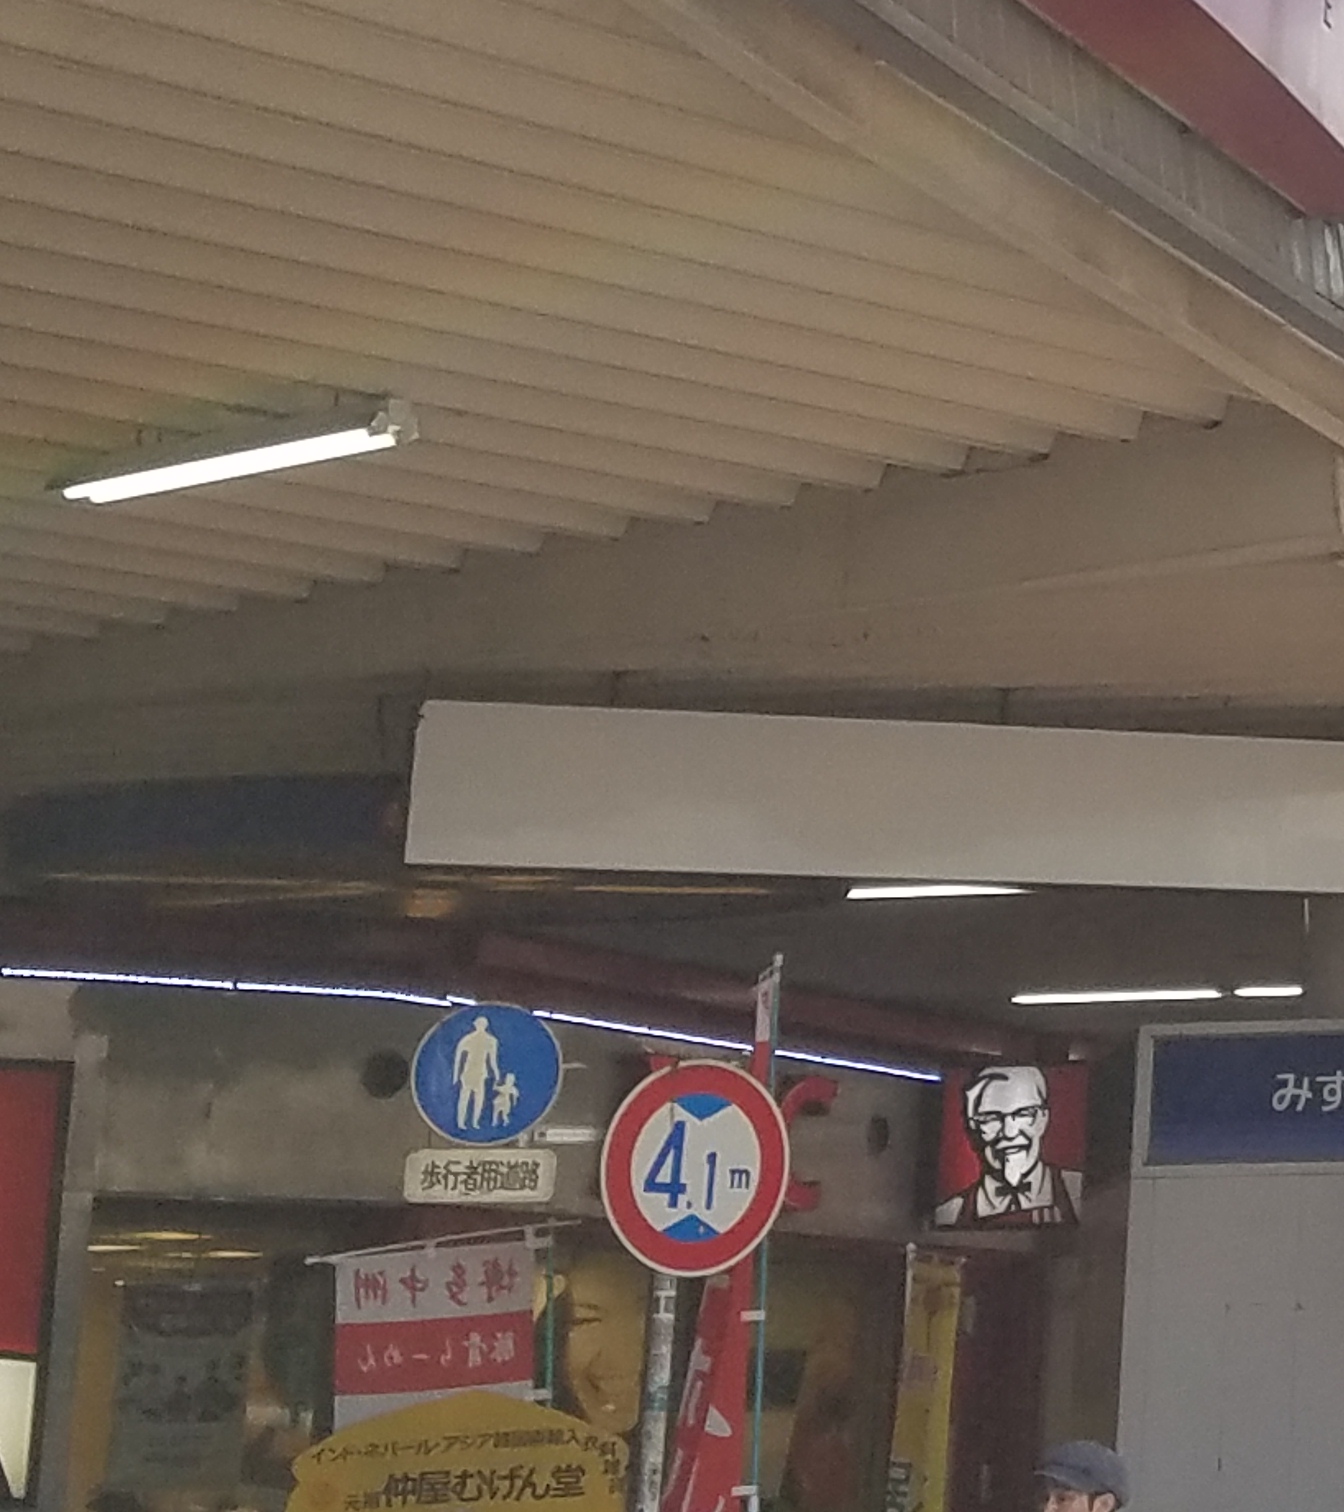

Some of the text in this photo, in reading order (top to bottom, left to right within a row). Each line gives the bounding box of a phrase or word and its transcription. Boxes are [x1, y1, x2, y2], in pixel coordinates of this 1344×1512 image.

[421, 1160, 540, 1191] 歩行者用道路
